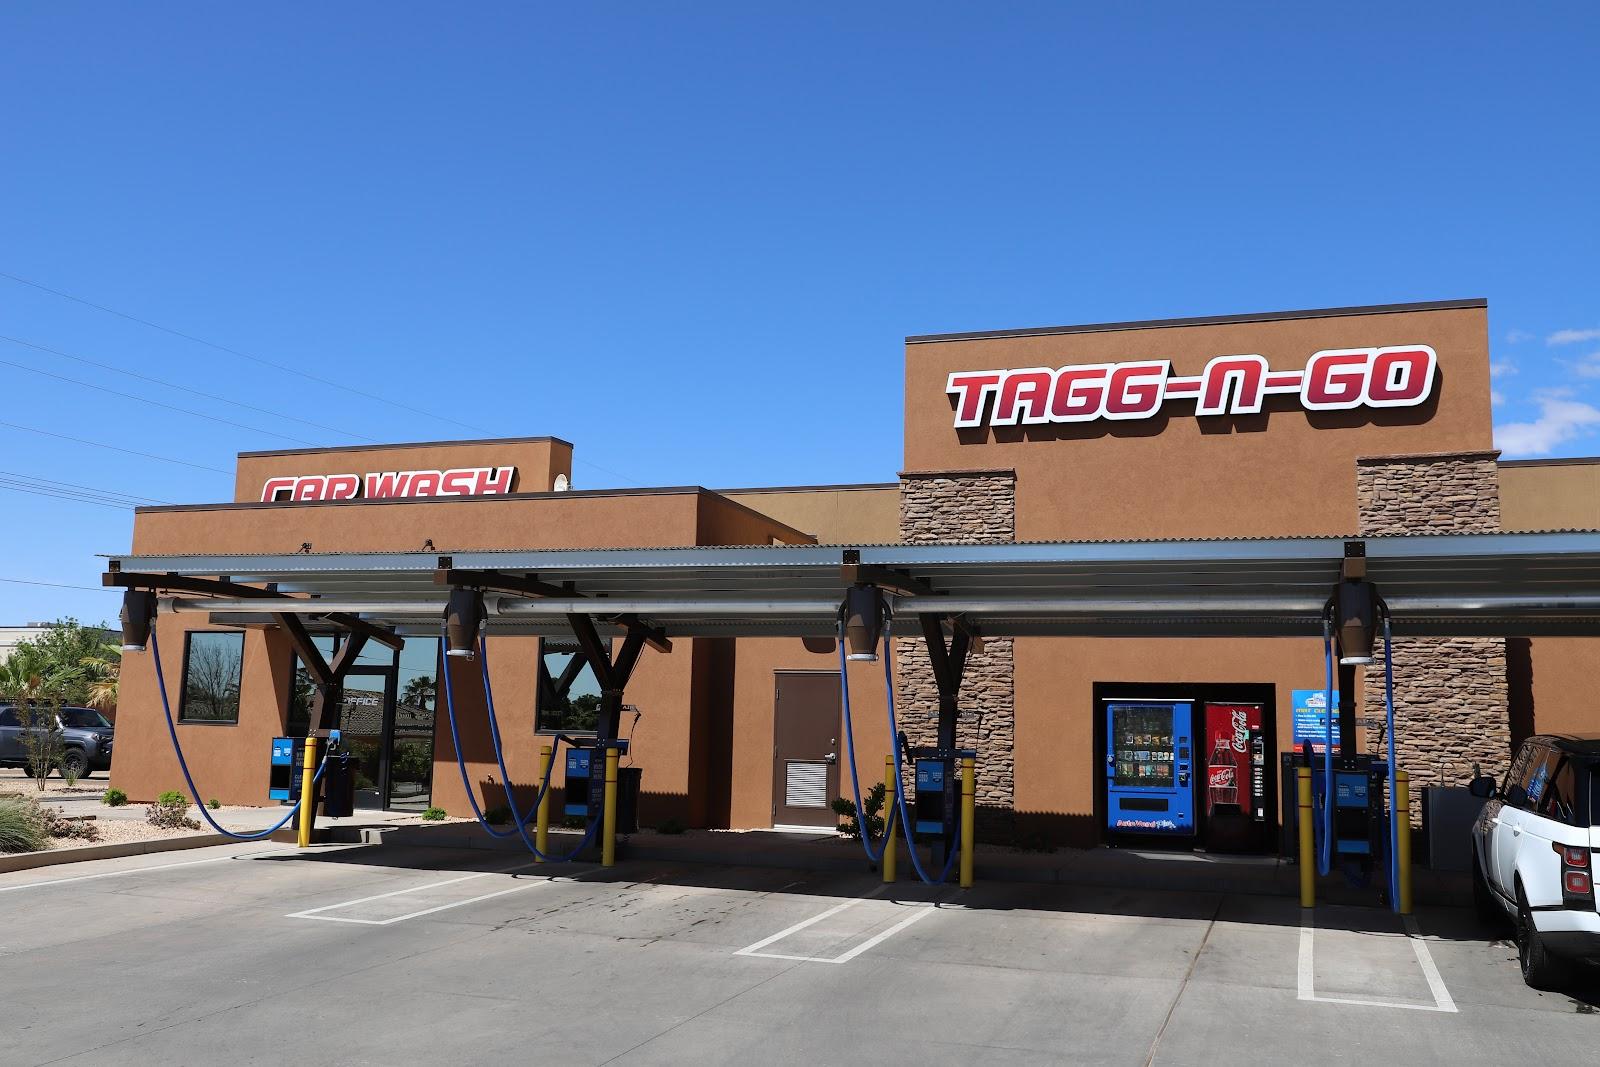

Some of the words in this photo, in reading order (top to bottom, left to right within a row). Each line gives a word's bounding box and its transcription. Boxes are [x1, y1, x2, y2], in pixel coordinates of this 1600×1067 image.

[945, 345, 1437, 428] TAGG-N-GO
[261, 473, 361, 503] CAR
[365, 466, 515, 499] WASH
